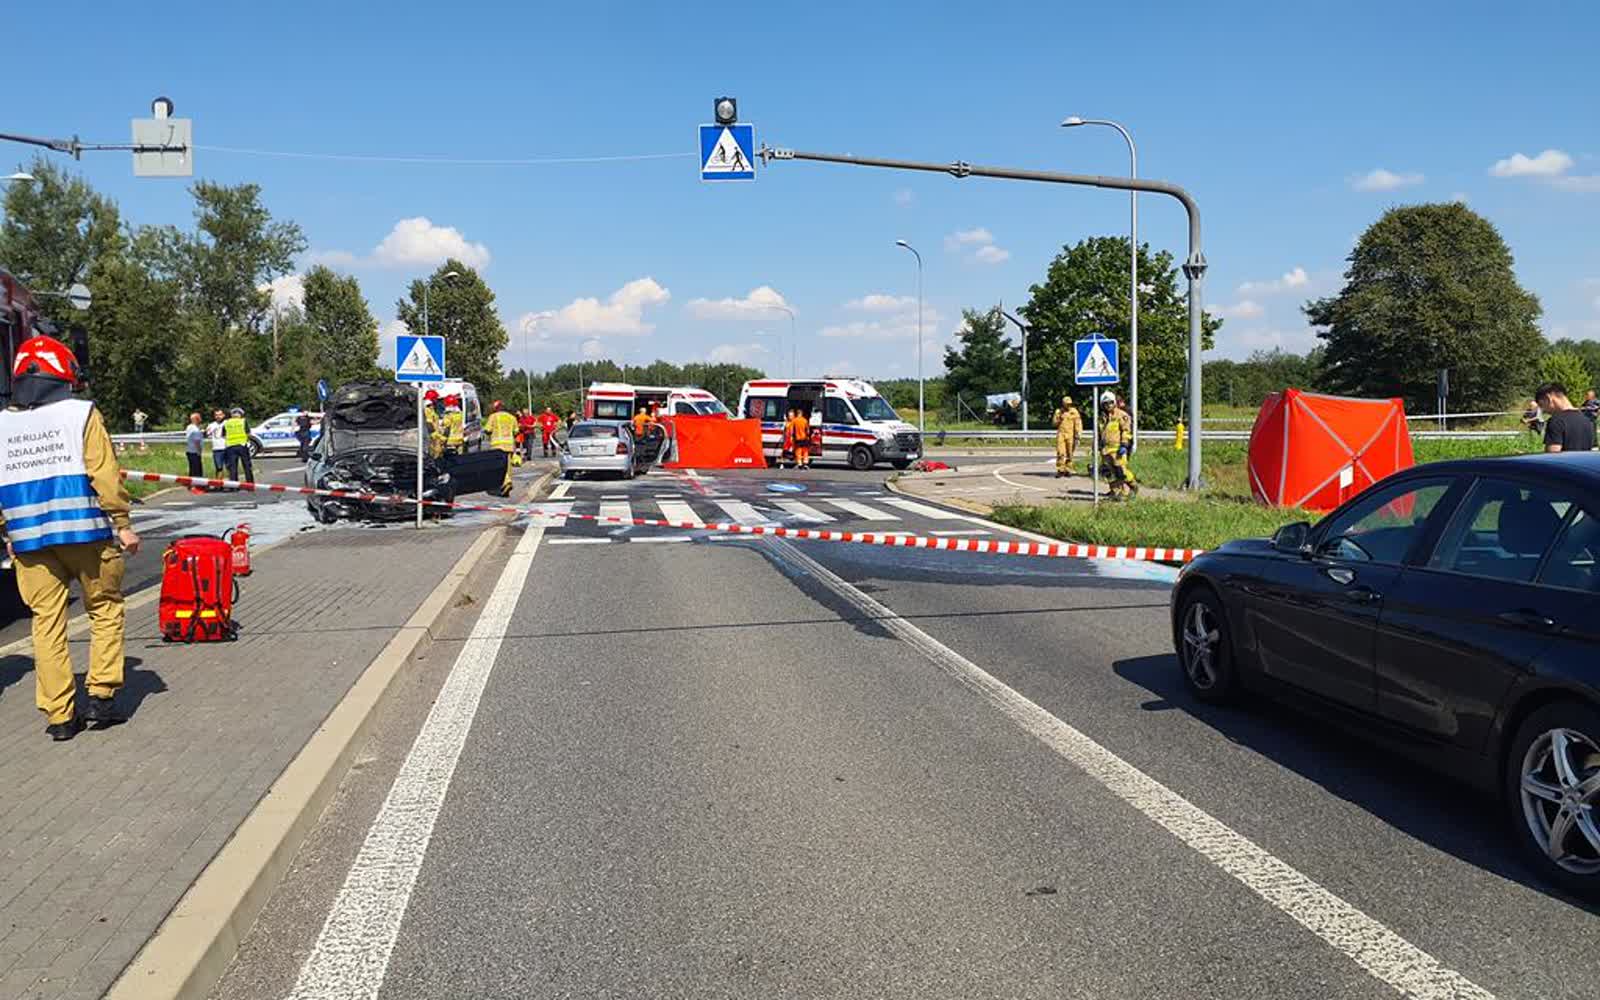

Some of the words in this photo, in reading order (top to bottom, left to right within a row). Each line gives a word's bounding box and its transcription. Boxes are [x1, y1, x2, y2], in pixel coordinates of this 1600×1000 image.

[7, 429, 62, 444] KIERUJĄCY
[7, 442, 65, 458] DZIAŁANIEM
[5, 455, 72, 471] RATOWNICZYM
